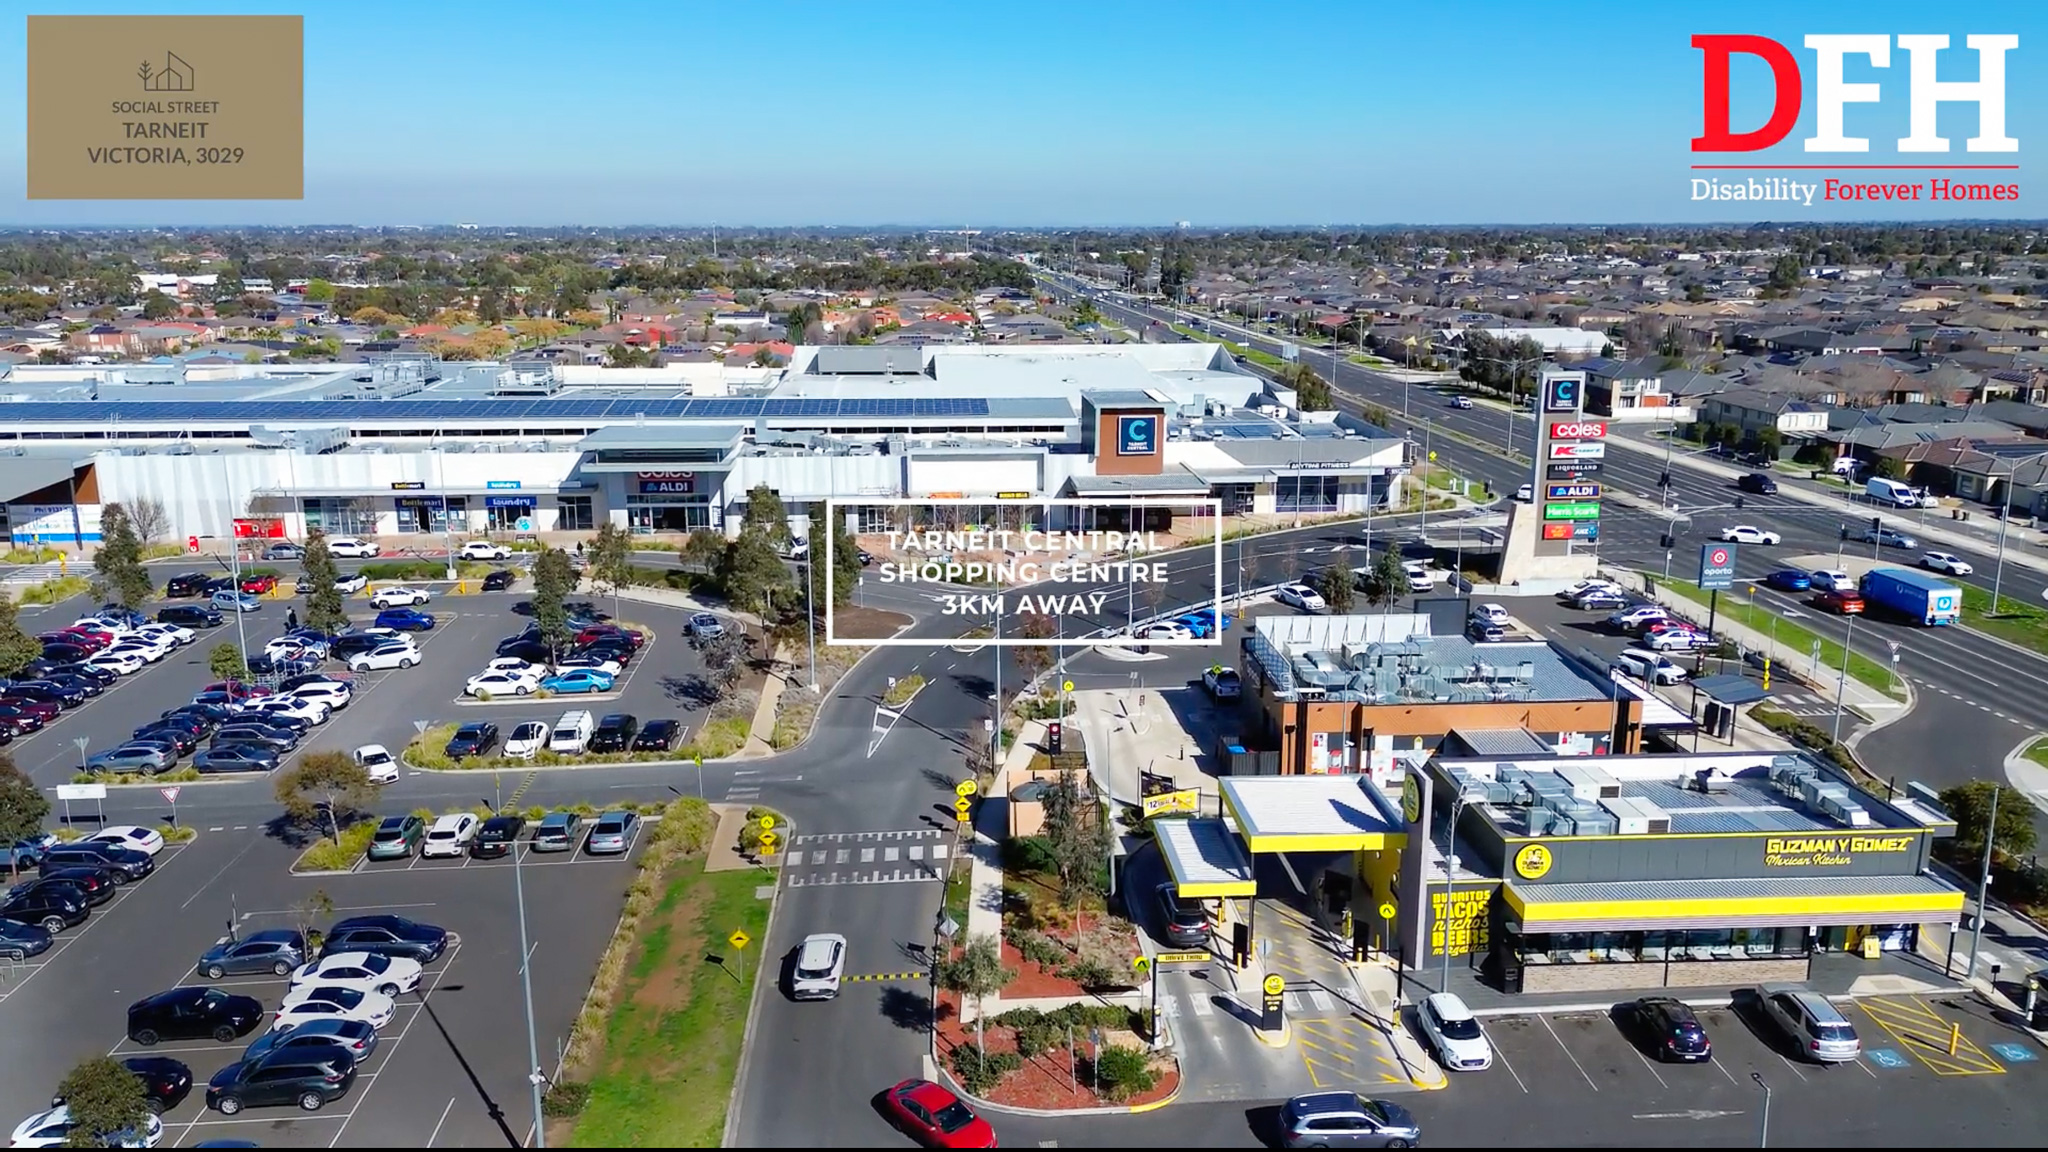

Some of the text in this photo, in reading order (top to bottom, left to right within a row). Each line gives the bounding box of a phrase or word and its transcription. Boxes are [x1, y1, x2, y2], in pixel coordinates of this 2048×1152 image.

[1556, 423, 1602, 437] coles
[659, 482, 688, 492] ALDI
[1567, 486, 1594, 496] ALDI
[1703, 567, 1733, 577] oporto
[1766, 836, 1908, 854] GUZMAN Y GOMEZ
[1765, 853, 1852, 866] Mexican Kitchen
[1432, 890, 1491, 904] BURRITOS
[1432, 900, 1490, 920] TACOS
[1431, 928, 1490, 947] BEERS
